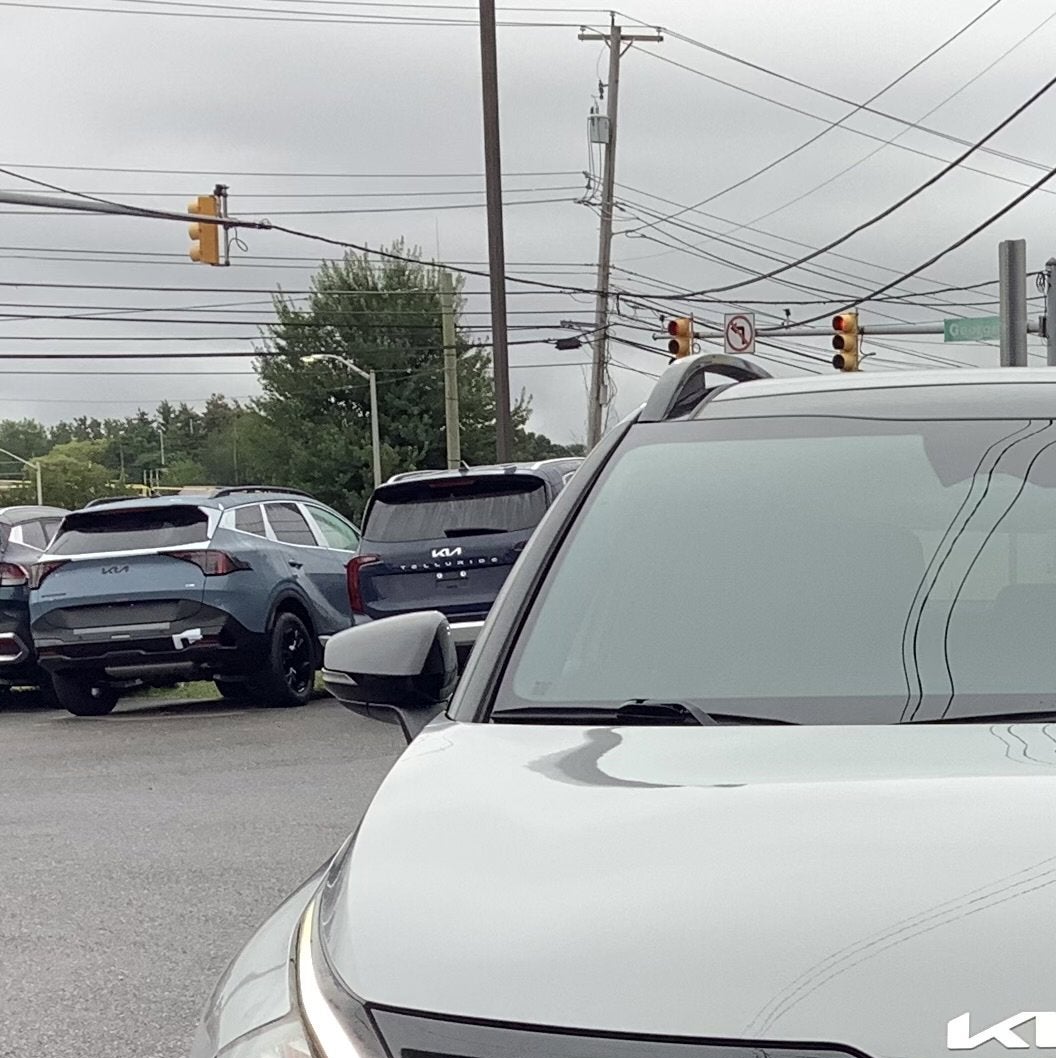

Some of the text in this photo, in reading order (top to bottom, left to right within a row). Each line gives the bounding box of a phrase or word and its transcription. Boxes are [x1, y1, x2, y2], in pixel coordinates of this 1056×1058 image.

[431, 546, 462, 558] KIA
[400, 557, 499, 570] TELLURIDE
[101, 565, 129, 575] KIA
